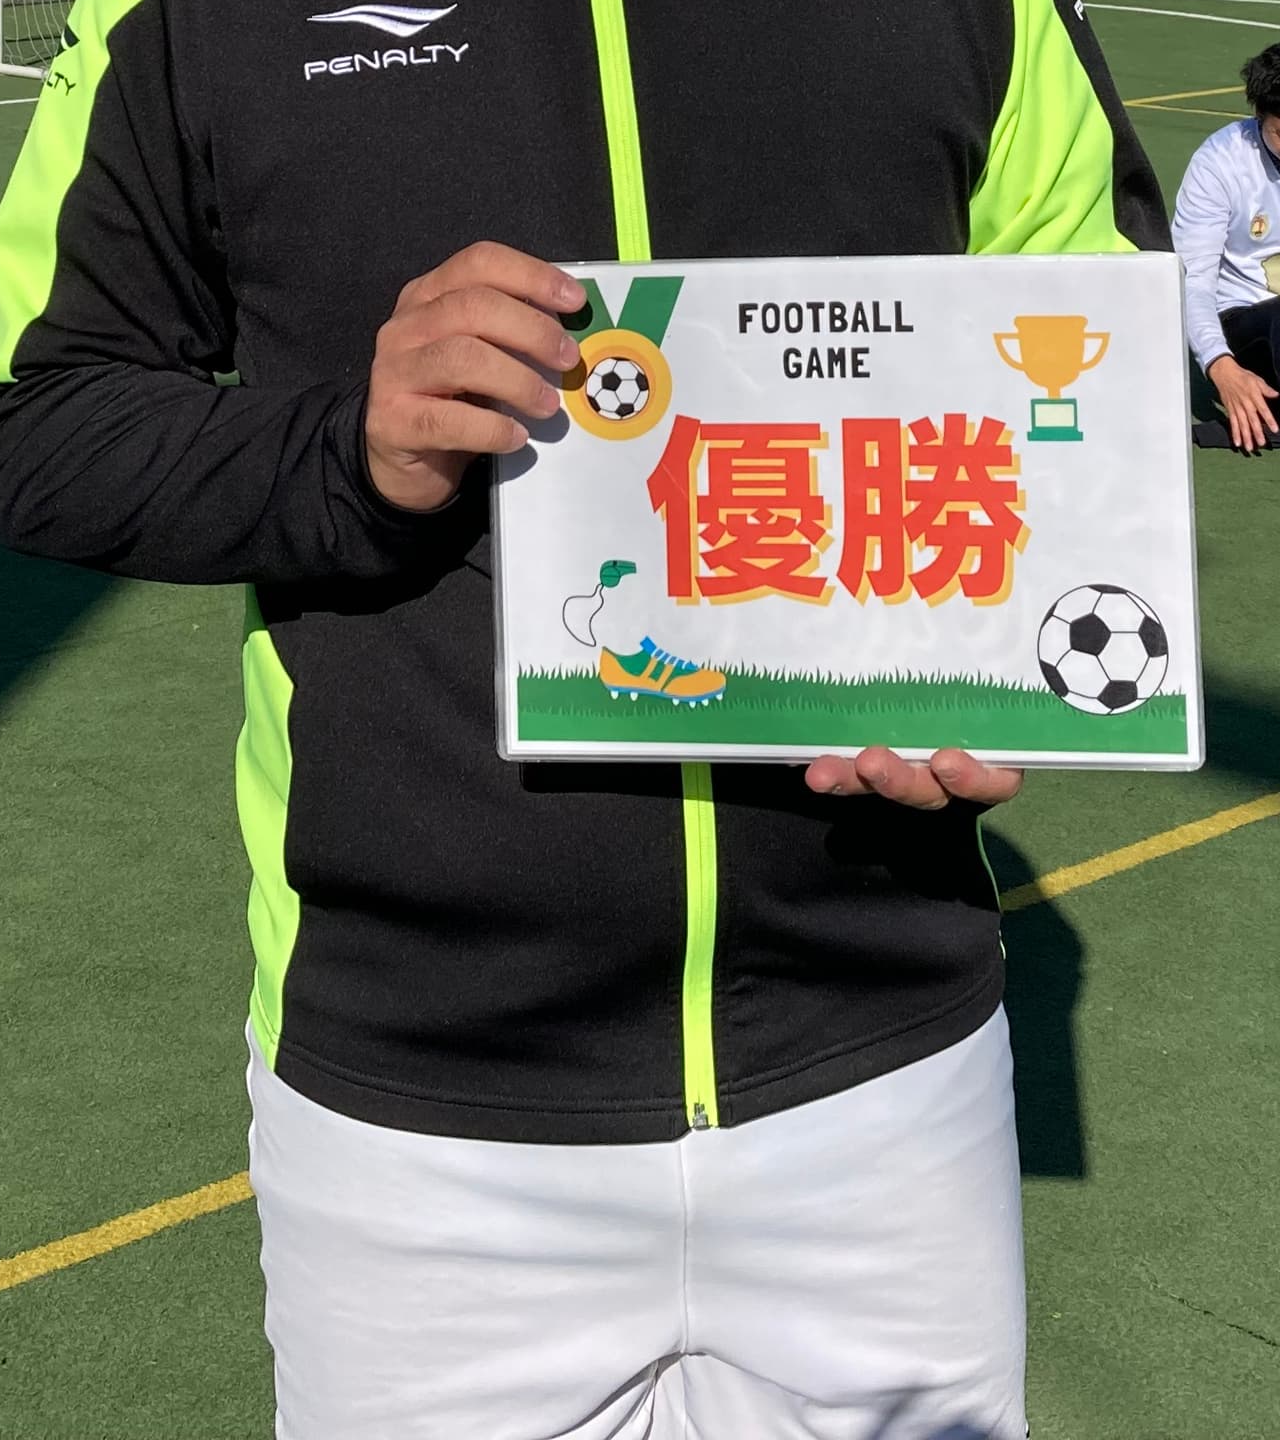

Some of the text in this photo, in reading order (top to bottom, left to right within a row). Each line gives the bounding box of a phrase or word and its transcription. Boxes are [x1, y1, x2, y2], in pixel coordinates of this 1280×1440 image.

[303, 42, 470, 81] PENALTY
[737, 300, 915, 335] FOOTBALL
[782, 346, 871, 380] GAME
[646, 412, 1029, 607] 優勝
